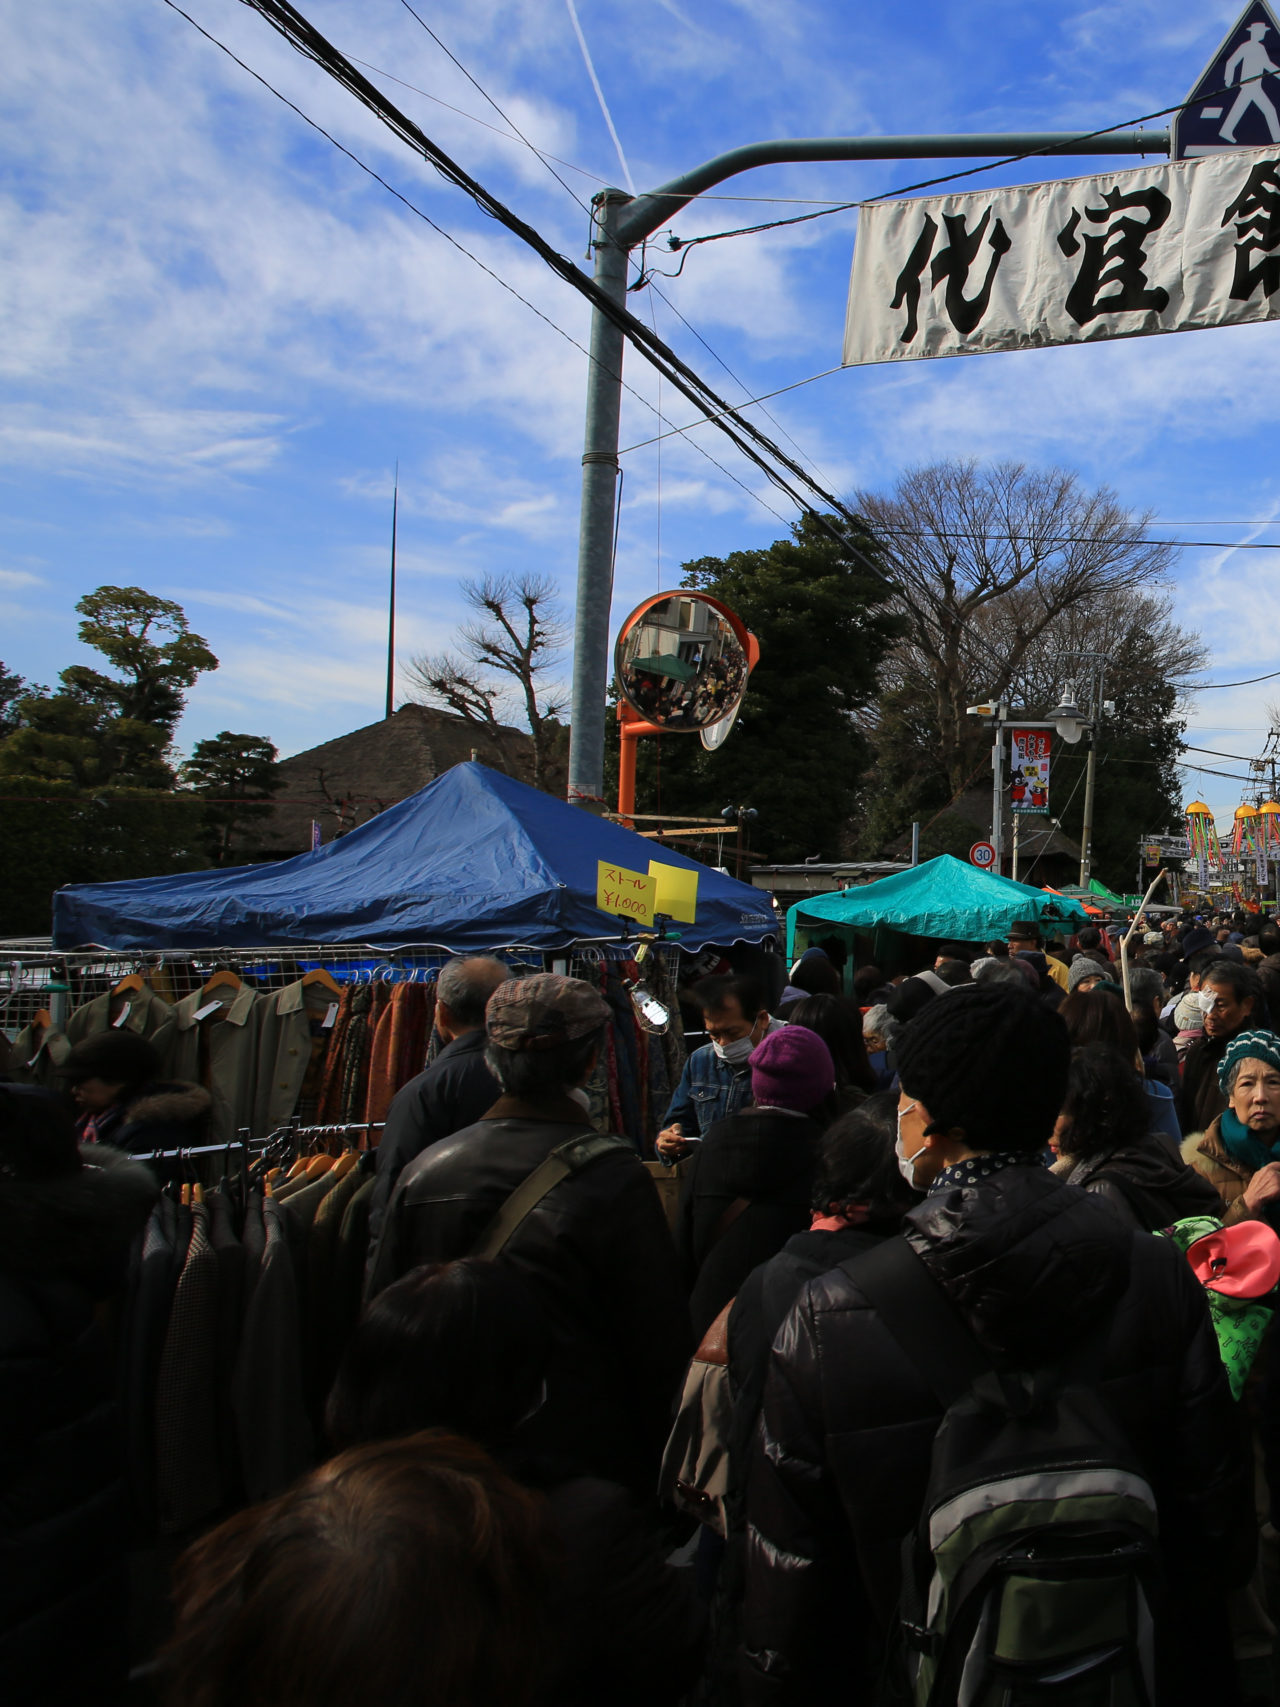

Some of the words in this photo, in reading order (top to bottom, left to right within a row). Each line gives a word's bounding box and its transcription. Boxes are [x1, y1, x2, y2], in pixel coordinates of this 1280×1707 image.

[976, 849, 990, 861] 30
[605, 868, 647, 890] ストール
